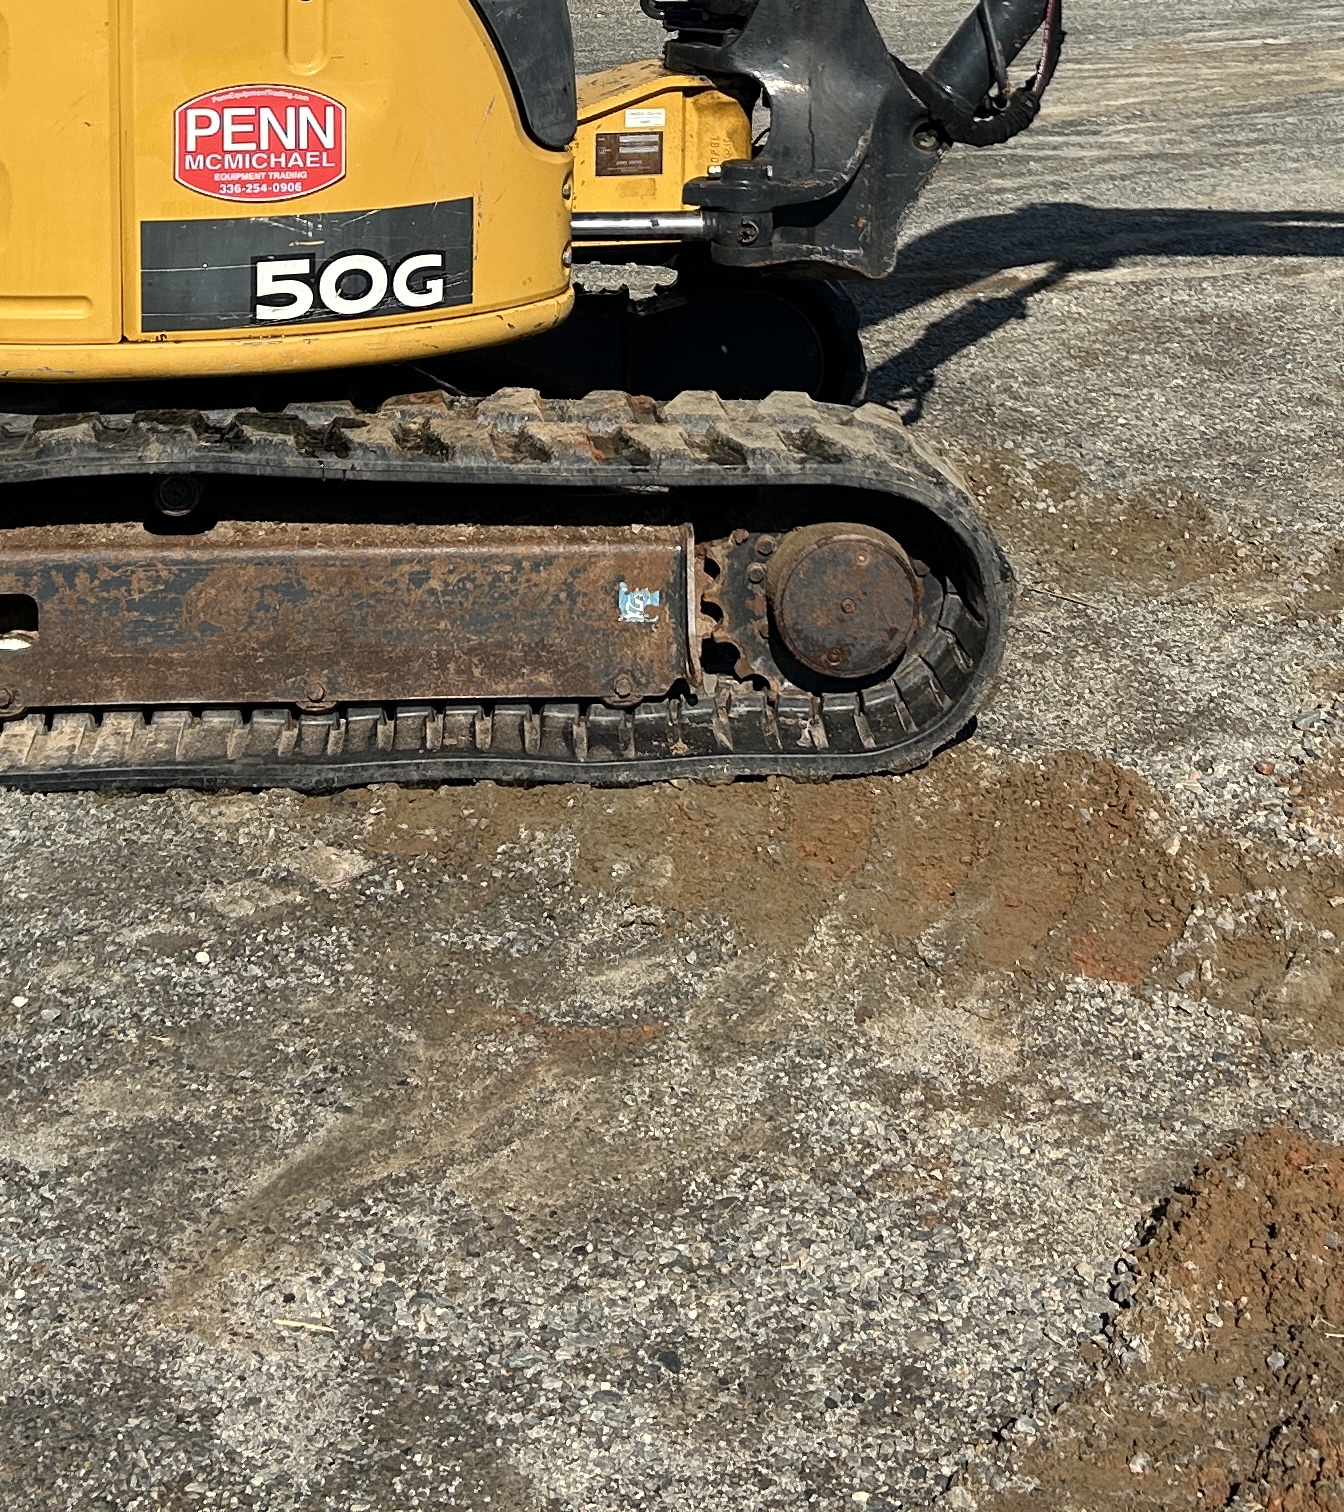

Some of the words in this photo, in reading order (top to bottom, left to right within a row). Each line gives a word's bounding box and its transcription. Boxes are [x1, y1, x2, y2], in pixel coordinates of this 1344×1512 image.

[185, 105, 335, 152] PENN
[184, 151, 336, 170] MCMICHAEL
[213, 171, 266, 181] EQUIPMENT
[268, 170, 308, 180] TRADING
[219, 182, 302, 194] 336-254-0906
[256, 253, 445, 320] 50G
